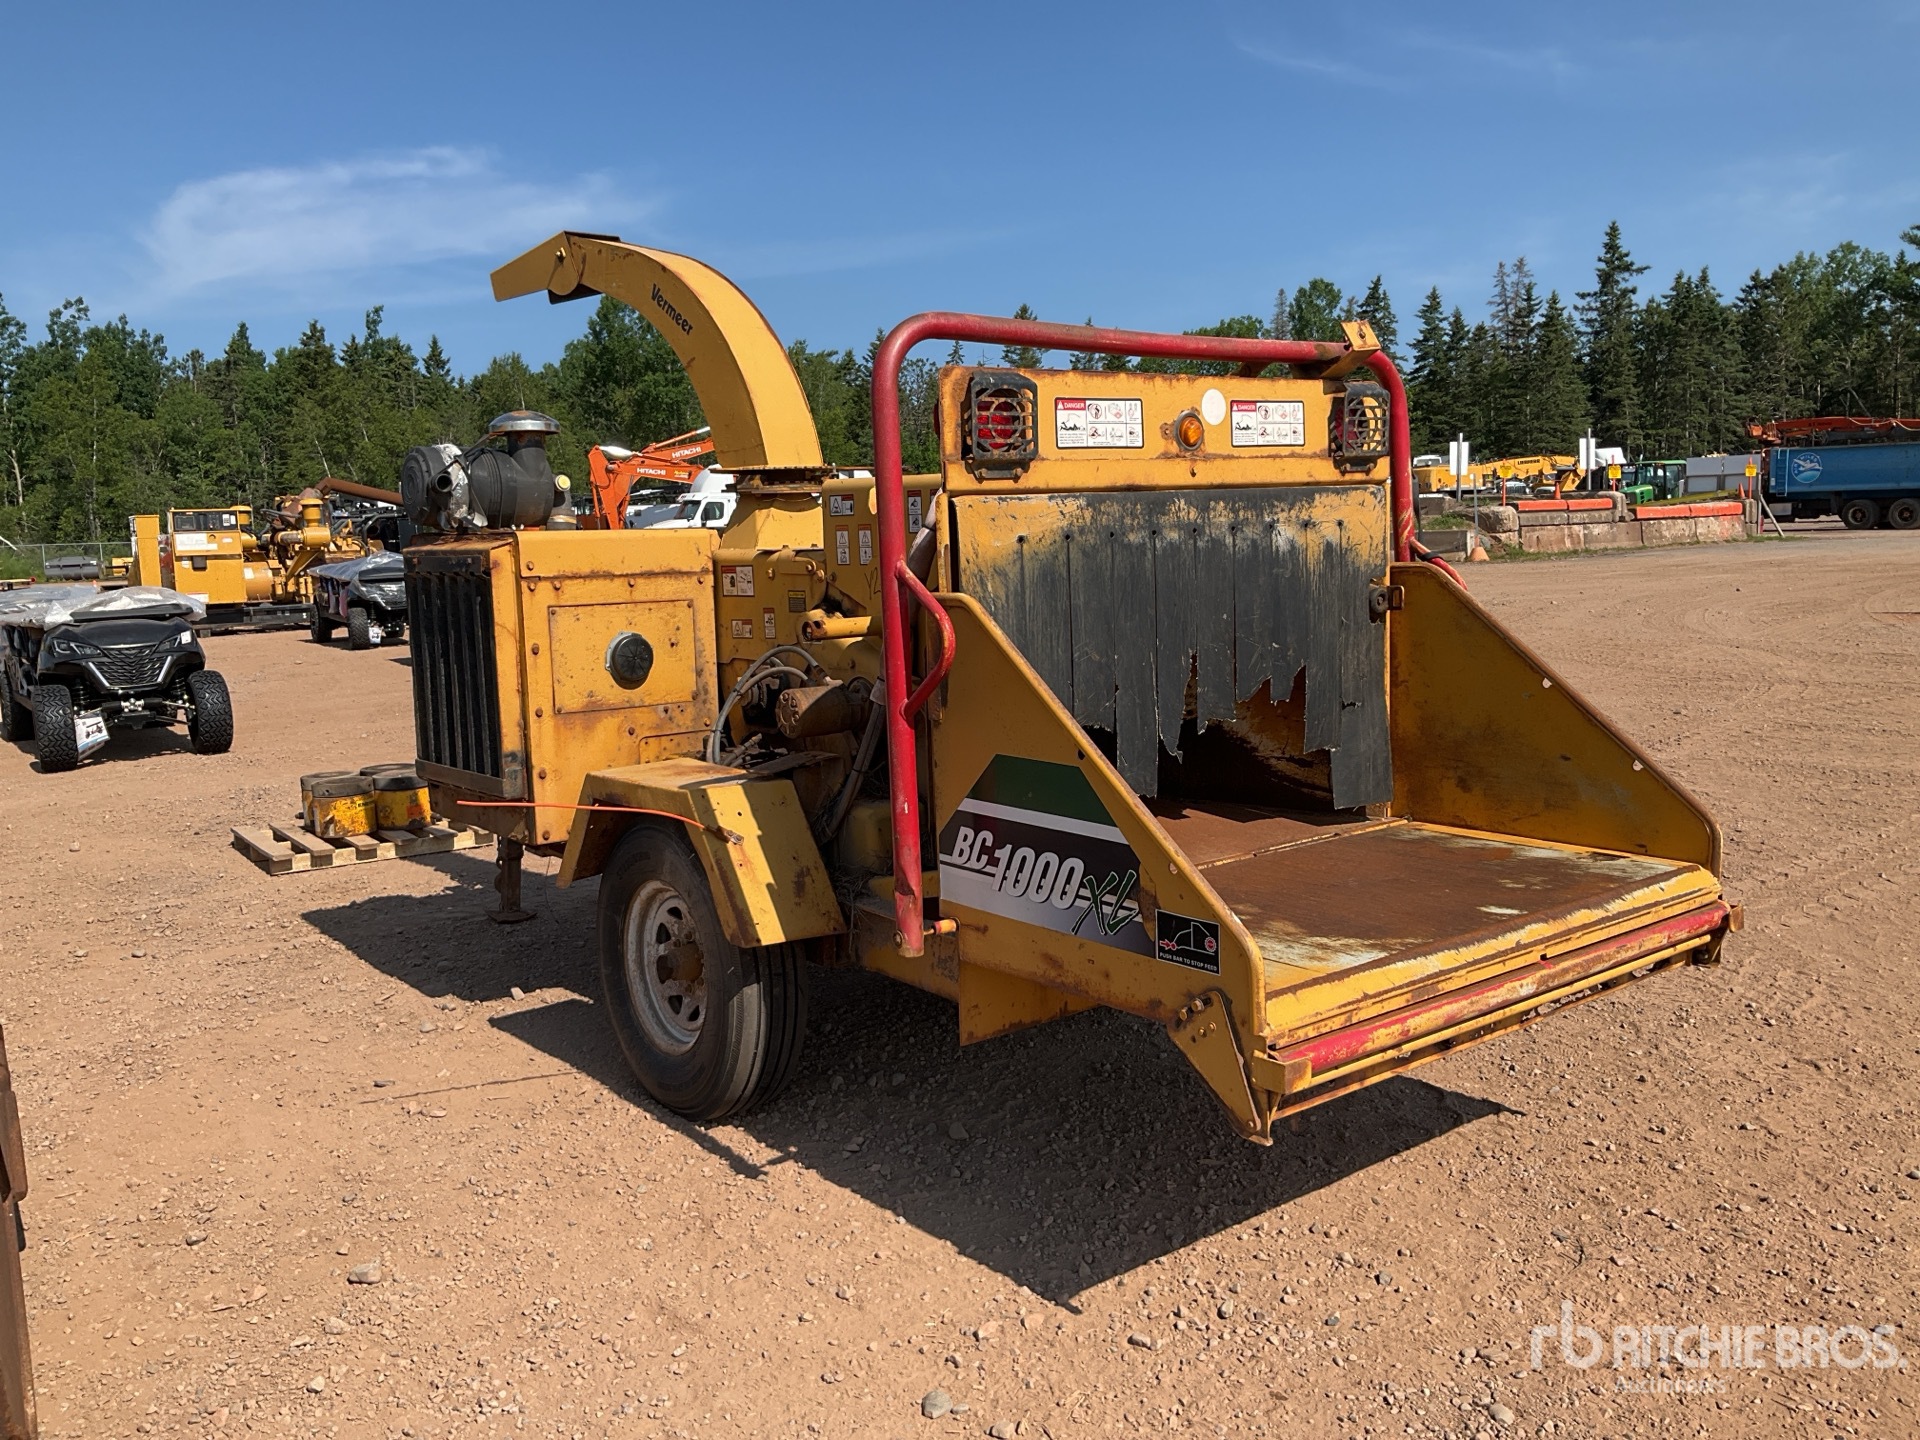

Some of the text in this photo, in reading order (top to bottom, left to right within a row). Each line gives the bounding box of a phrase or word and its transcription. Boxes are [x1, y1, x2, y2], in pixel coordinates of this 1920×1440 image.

[651, 283, 694, 335] Vermeer
[1064, 402, 1085, 410] DANGER
[671, 446, 702, 459] HITACHI
[636, 467, 666, 475] HITACHI
[1160, 952, 1172, 960] PUSH
[1173, 955, 1183, 963] BAR
[1205, 963, 1217, 971] FEED
